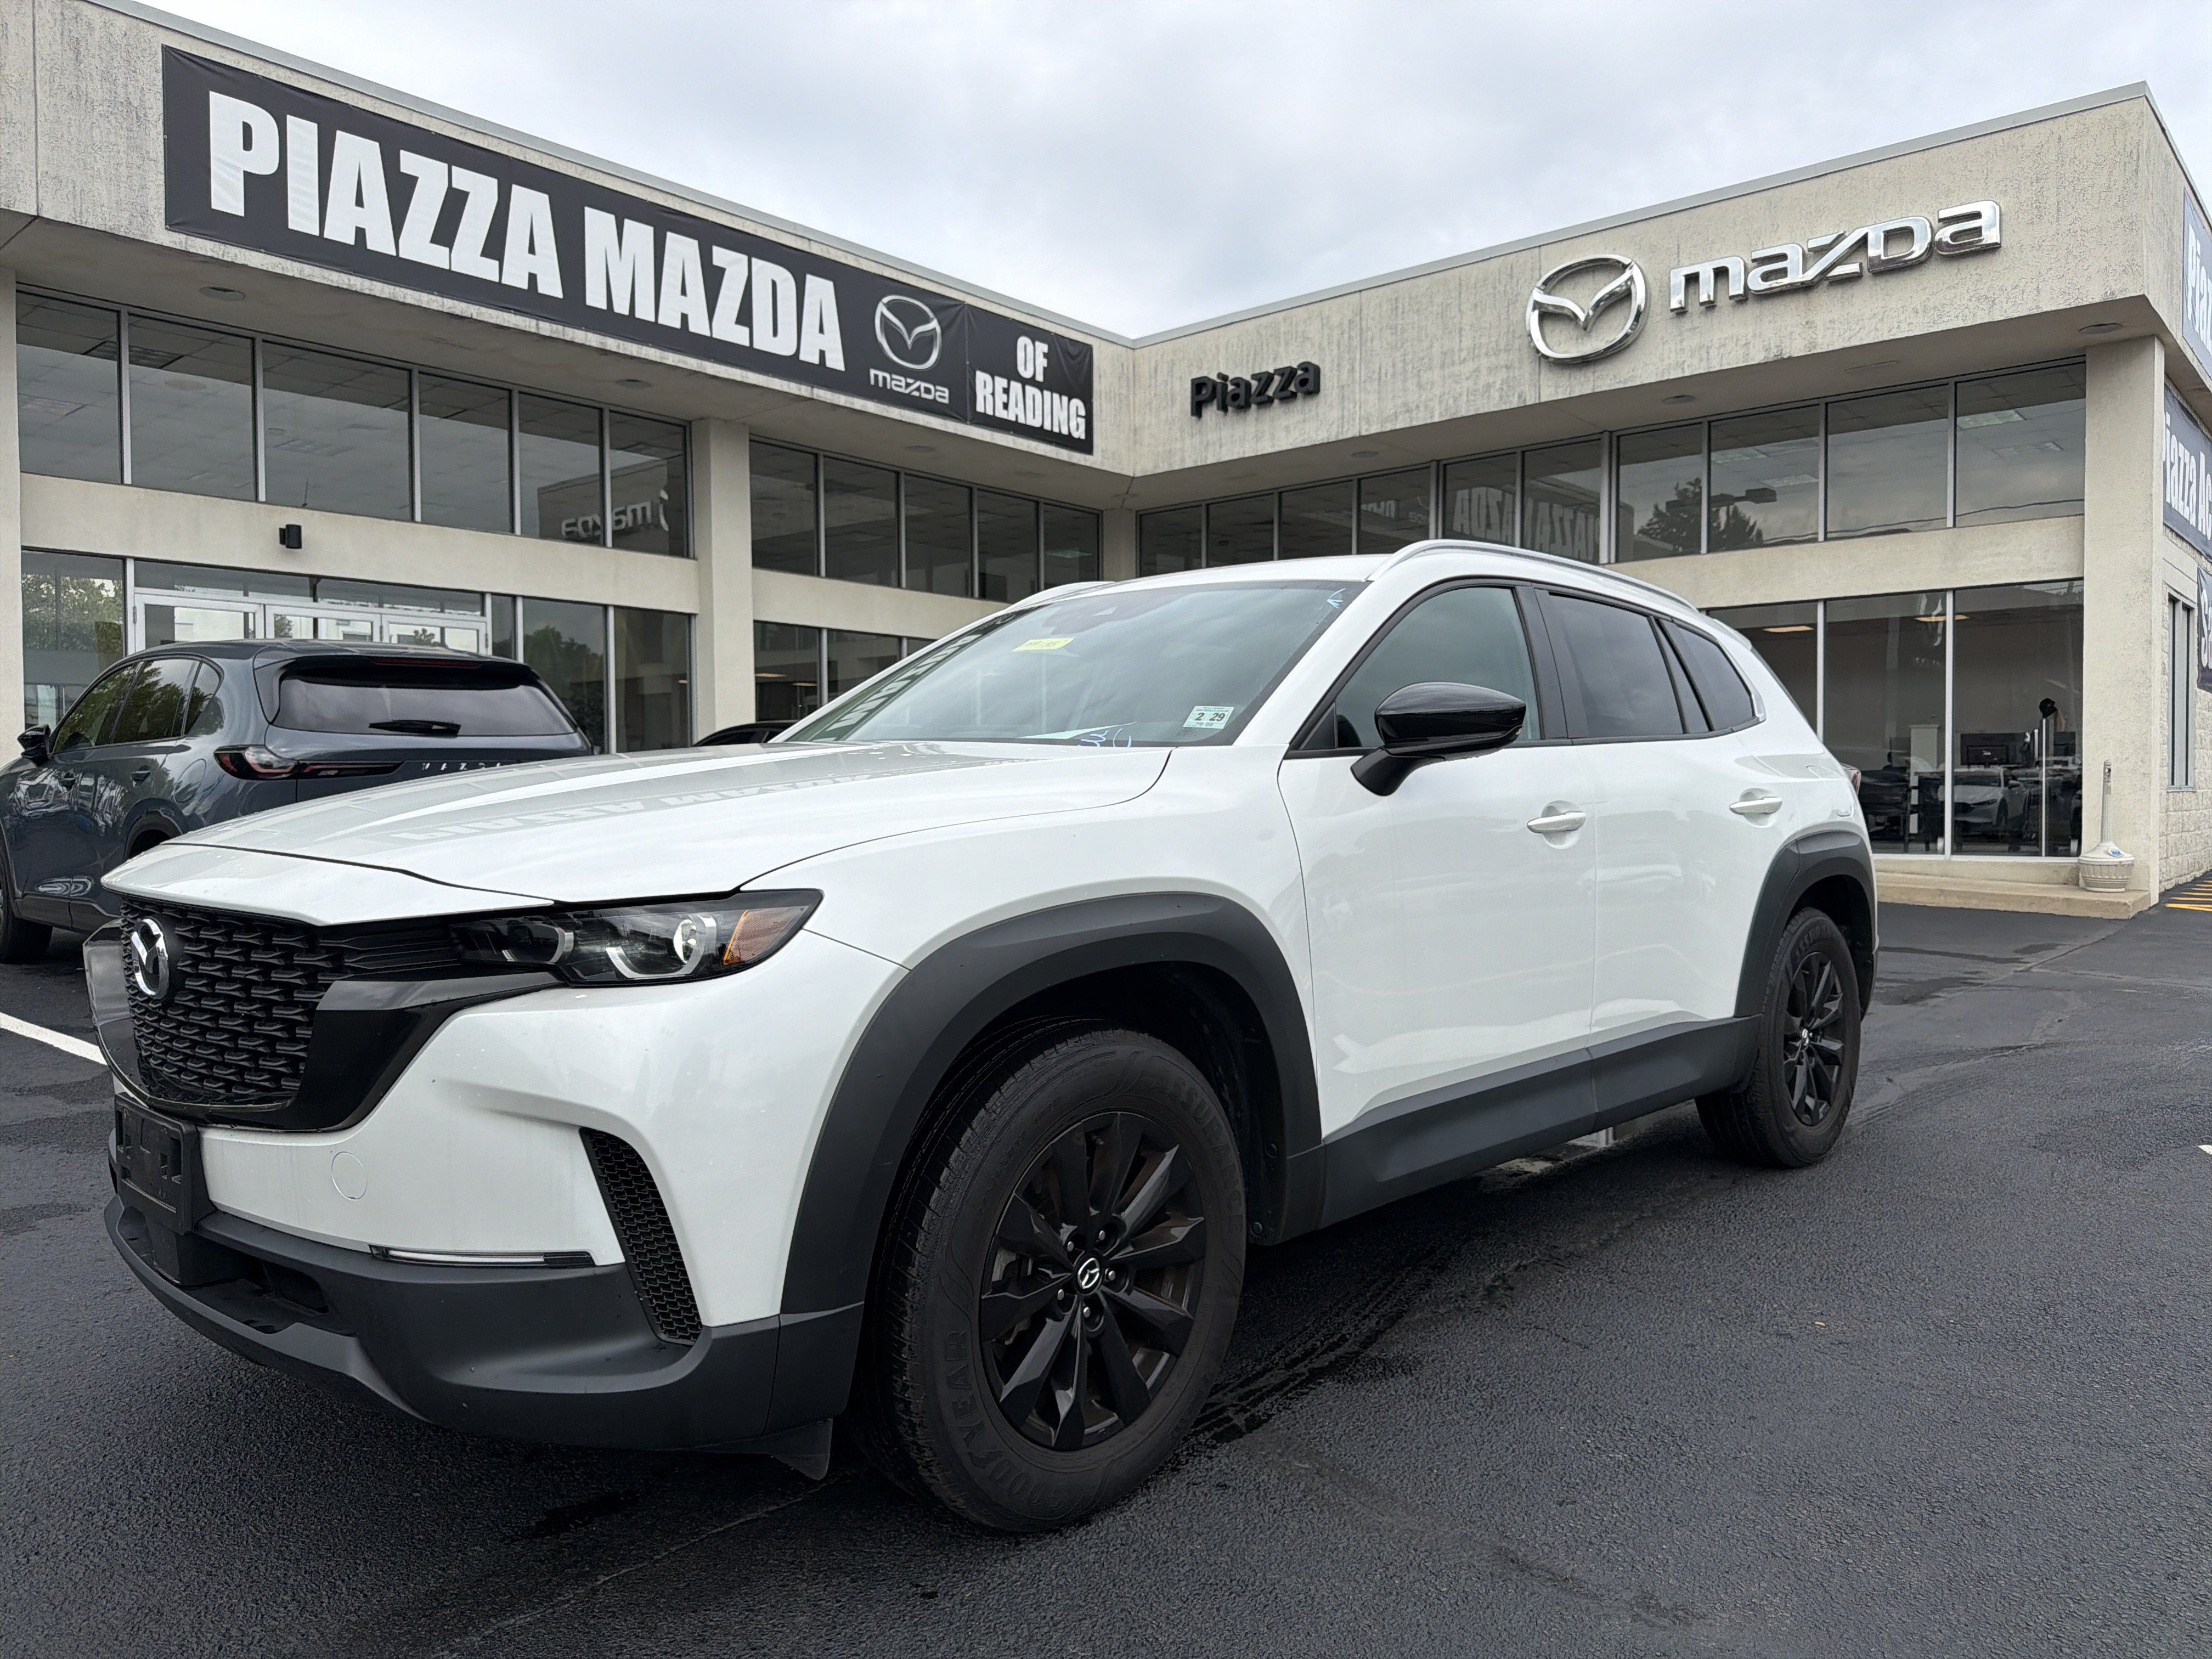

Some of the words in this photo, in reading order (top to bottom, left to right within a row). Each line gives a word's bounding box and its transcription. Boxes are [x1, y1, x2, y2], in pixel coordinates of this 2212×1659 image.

[209, 91, 563, 299] PIAZZA
[584, 206, 845, 371] MAZDA
[1669, 199, 2002, 313] mazda
[870, 368, 950, 404] mazda
[1017, 335, 1048, 382] OF
[1190, 361, 1321, 419] Piazza
[975, 370, 1086, 440] READING
[1194, 712, 1205, 721] 2
[1209, 712, 1226, 722] 29
[1150, 1053, 1244, 1234] ASSURANCE
[944, 1329, 1066, 1510] GOODYEAR
